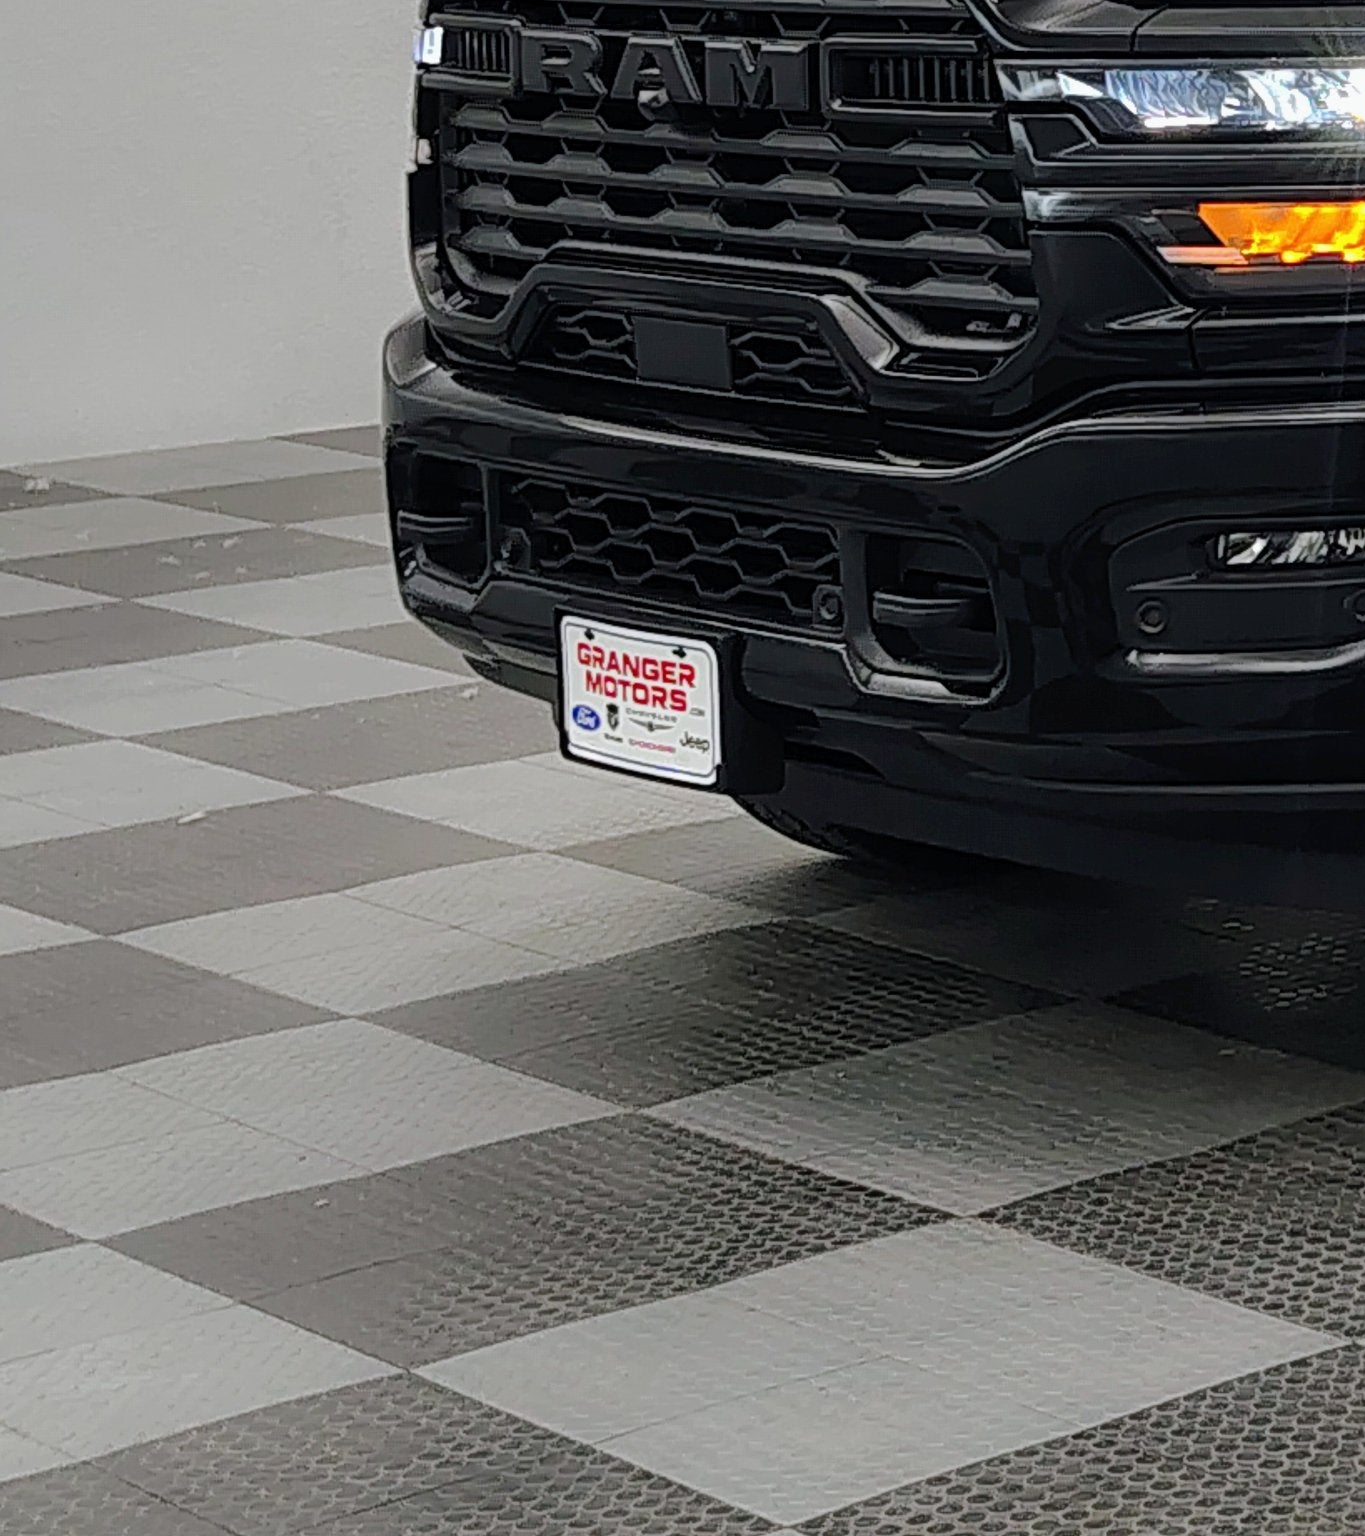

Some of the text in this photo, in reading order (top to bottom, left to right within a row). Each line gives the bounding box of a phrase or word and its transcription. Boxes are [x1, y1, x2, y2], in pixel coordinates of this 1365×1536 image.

[521, 30, 808, 110] RAM
[577, 642, 696, 689] GRANGER
[586, 670, 687, 712] MOTORS
[680, 731, 710, 754] Jeep
